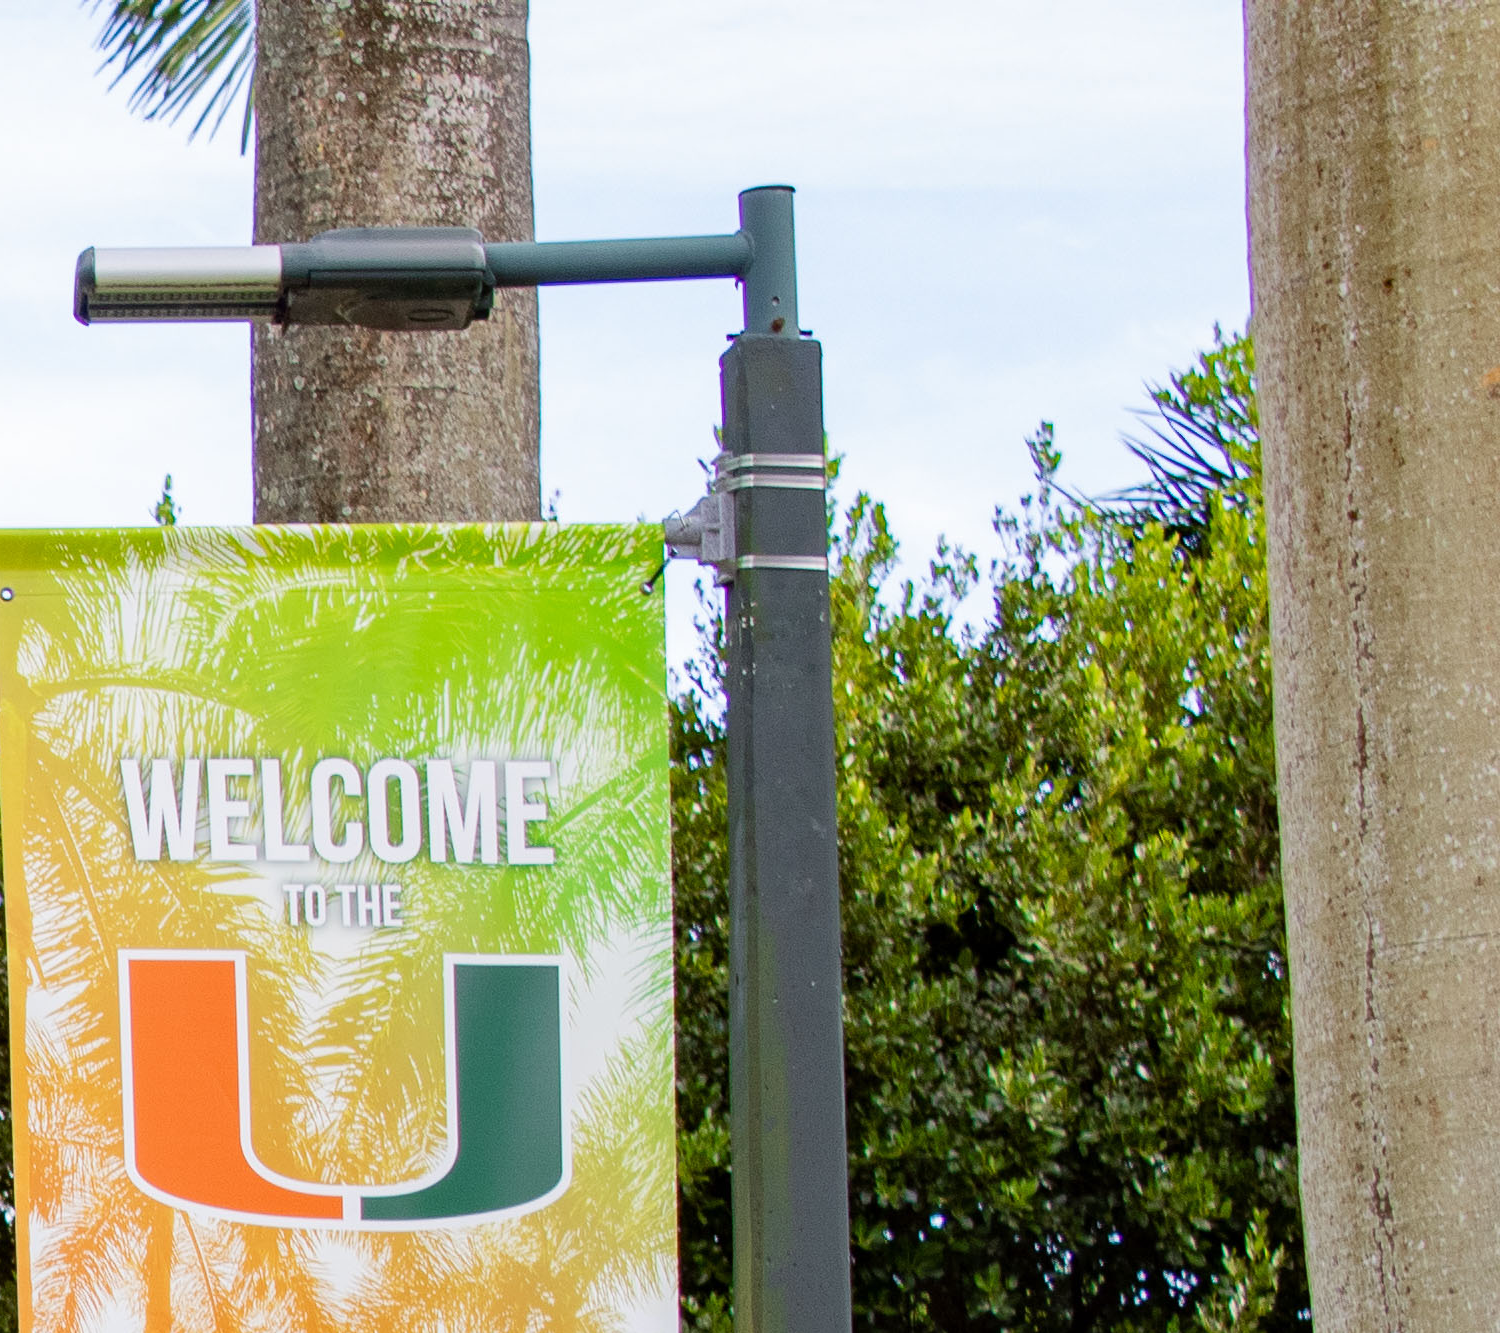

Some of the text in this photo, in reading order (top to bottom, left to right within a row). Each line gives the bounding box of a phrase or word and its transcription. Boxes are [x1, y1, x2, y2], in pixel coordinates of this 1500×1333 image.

[120, 757, 556, 866] WELCOME
[283, 884, 403, 928] TO THE
[117, 948, 573, 1231] U
